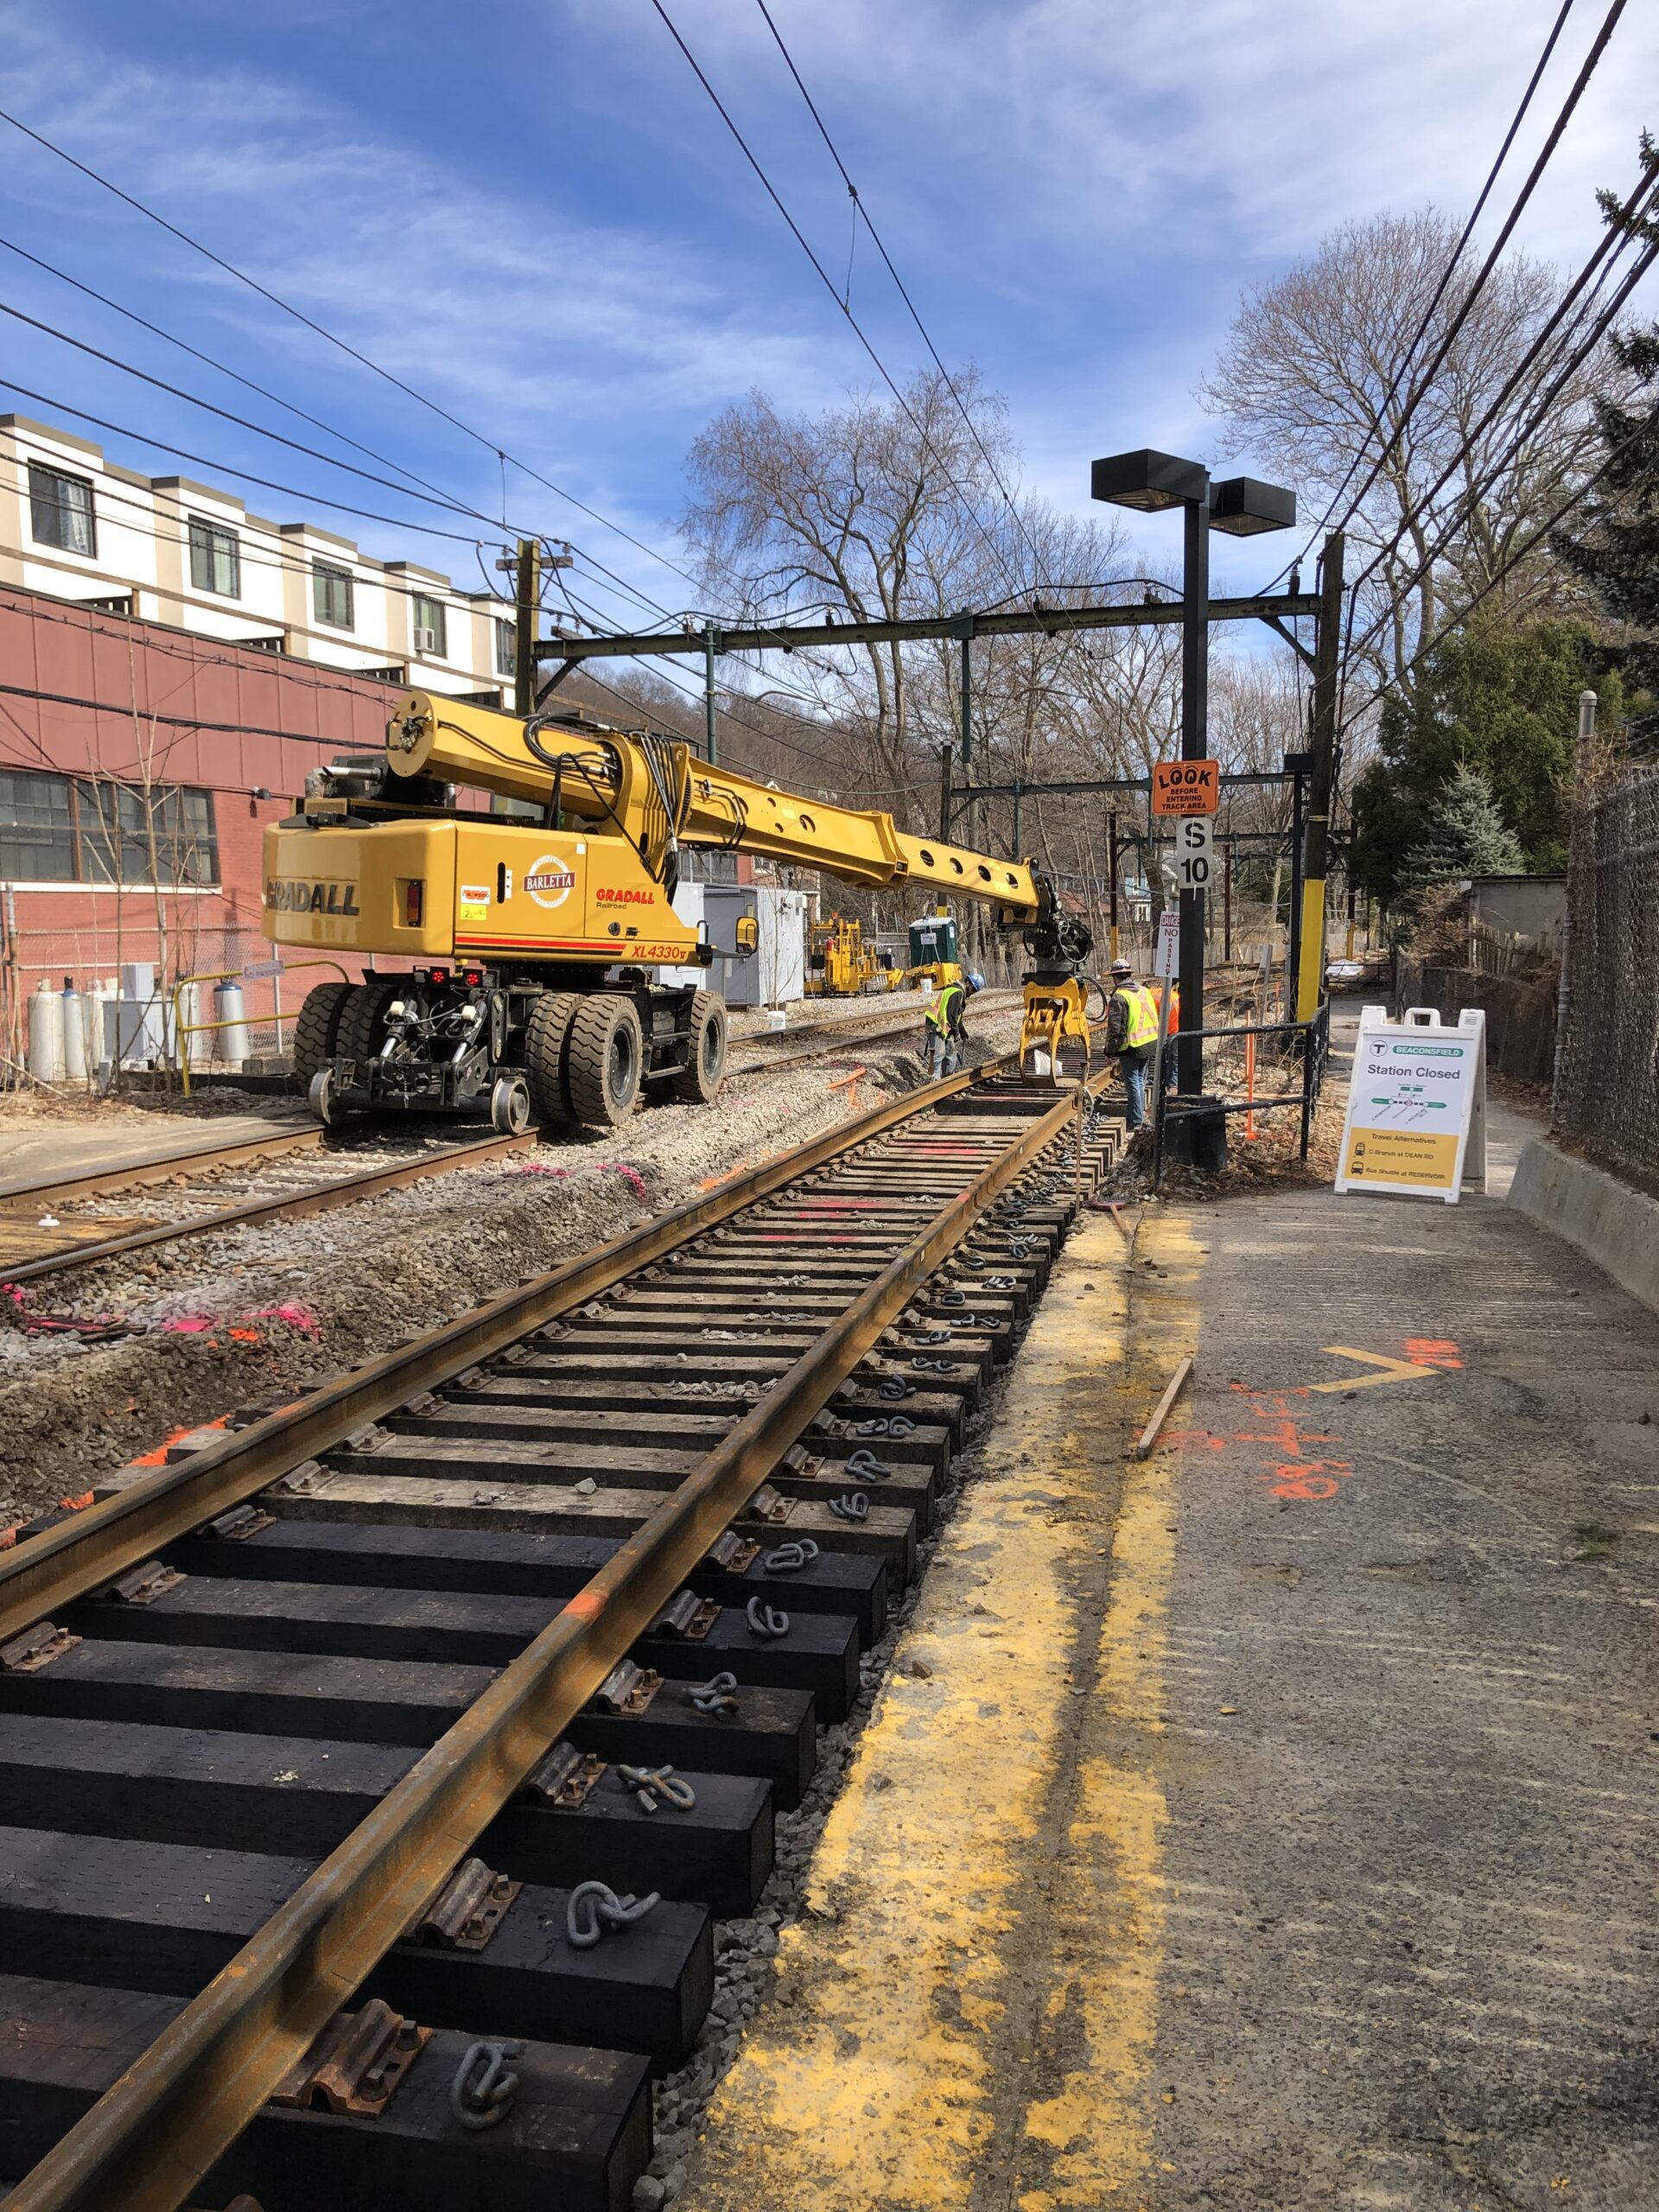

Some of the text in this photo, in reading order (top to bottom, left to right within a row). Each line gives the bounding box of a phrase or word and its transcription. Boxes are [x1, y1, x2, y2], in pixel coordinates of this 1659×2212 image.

[1159, 768, 1212, 790] LOOK
[1185, 822, 1206, 849] S
[1180, 857, 1209, 883] 10
[526, 874, 571, 890] BARLETTA
[595, 887, 655, 905] GRADALL
[596, 901, 627, 910] Railroad
[1161, 916, 1180, 926] DANGE
[1164, 928, 1179, 938] NO
[1373, 1044, 1460, 1057] T BEACONSFIELD
[1368, 1064, 1460, 1080] Station Closed
[1394, 1135, 1436, 1145] Alternatives
[1408, 1171, 1446, 1180] RESERVOIR
